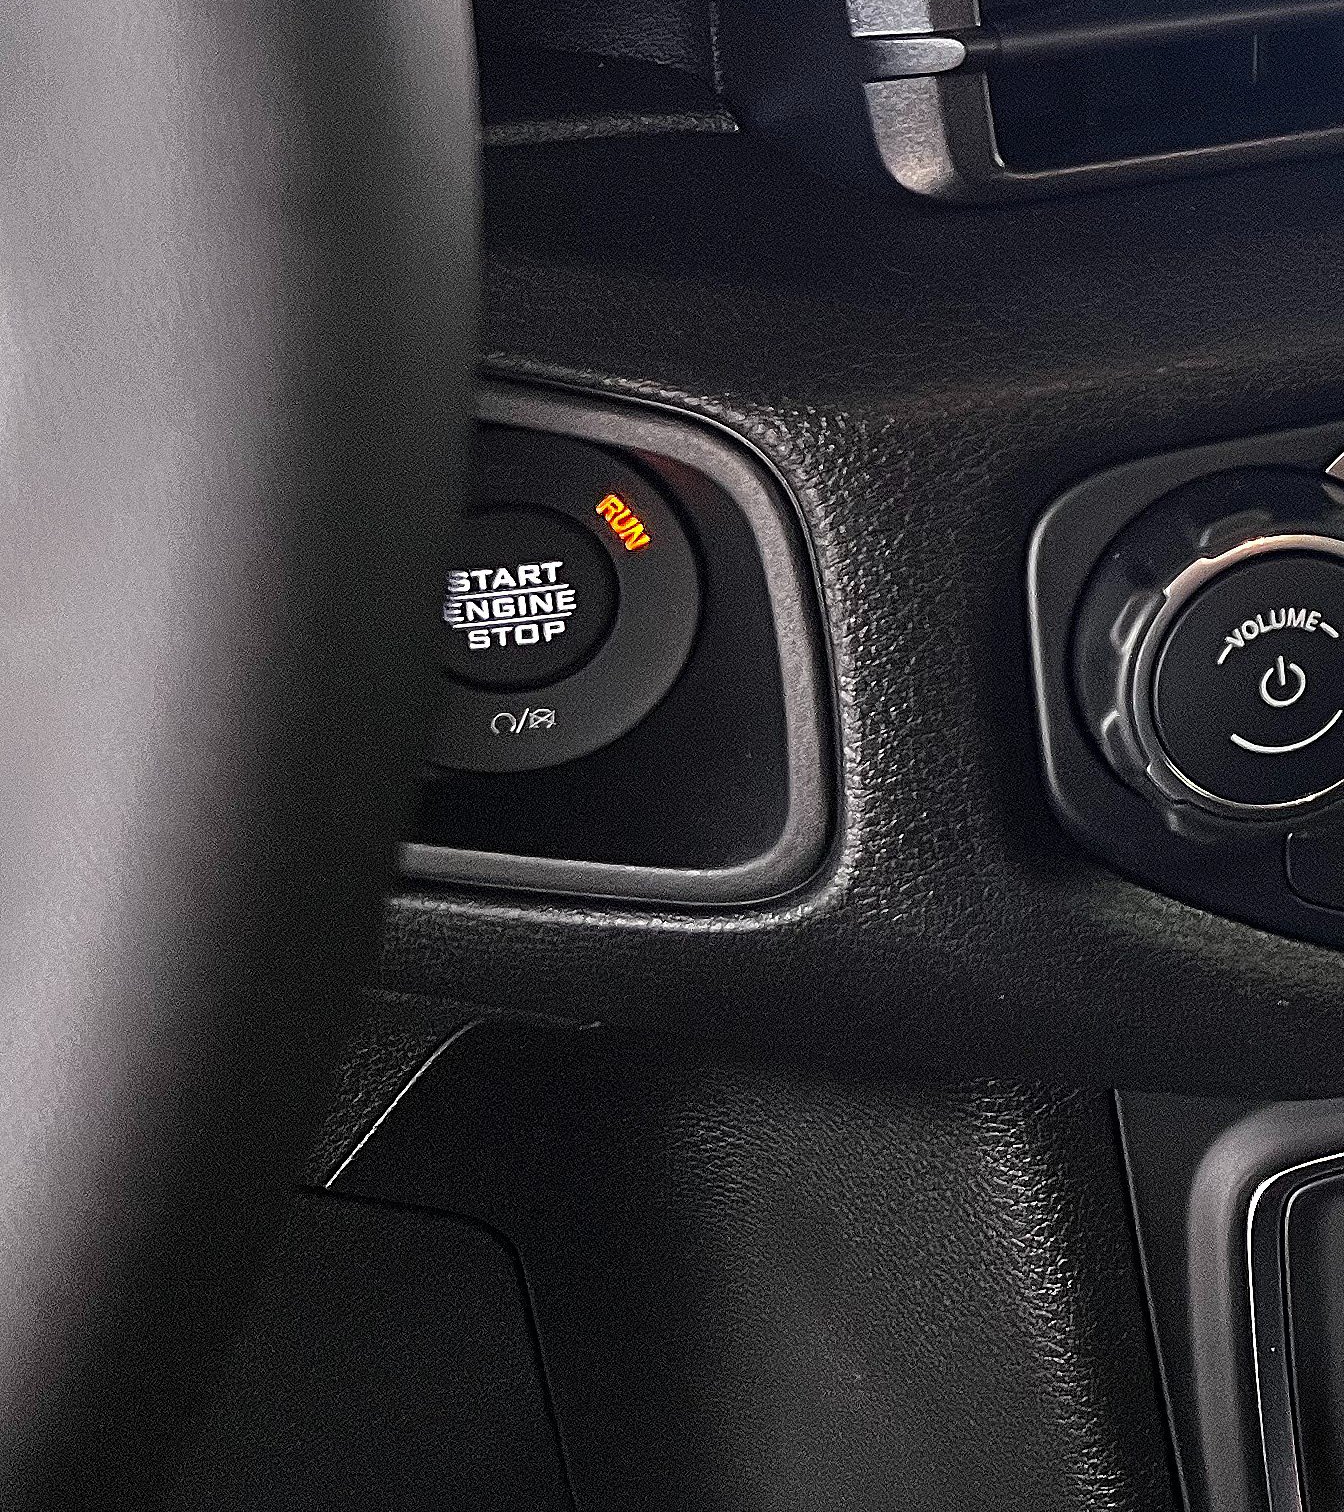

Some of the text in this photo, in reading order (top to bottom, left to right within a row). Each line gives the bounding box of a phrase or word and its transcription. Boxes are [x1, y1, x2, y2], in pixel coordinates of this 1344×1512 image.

[595, 494, 651, 551] RUN
[447, 561, 564, 592] START
[443, 589, 577, 622] ENGINE
[467, 621, 566, 650] STOP
[1225, 607, 1322, 648] VOLUME
